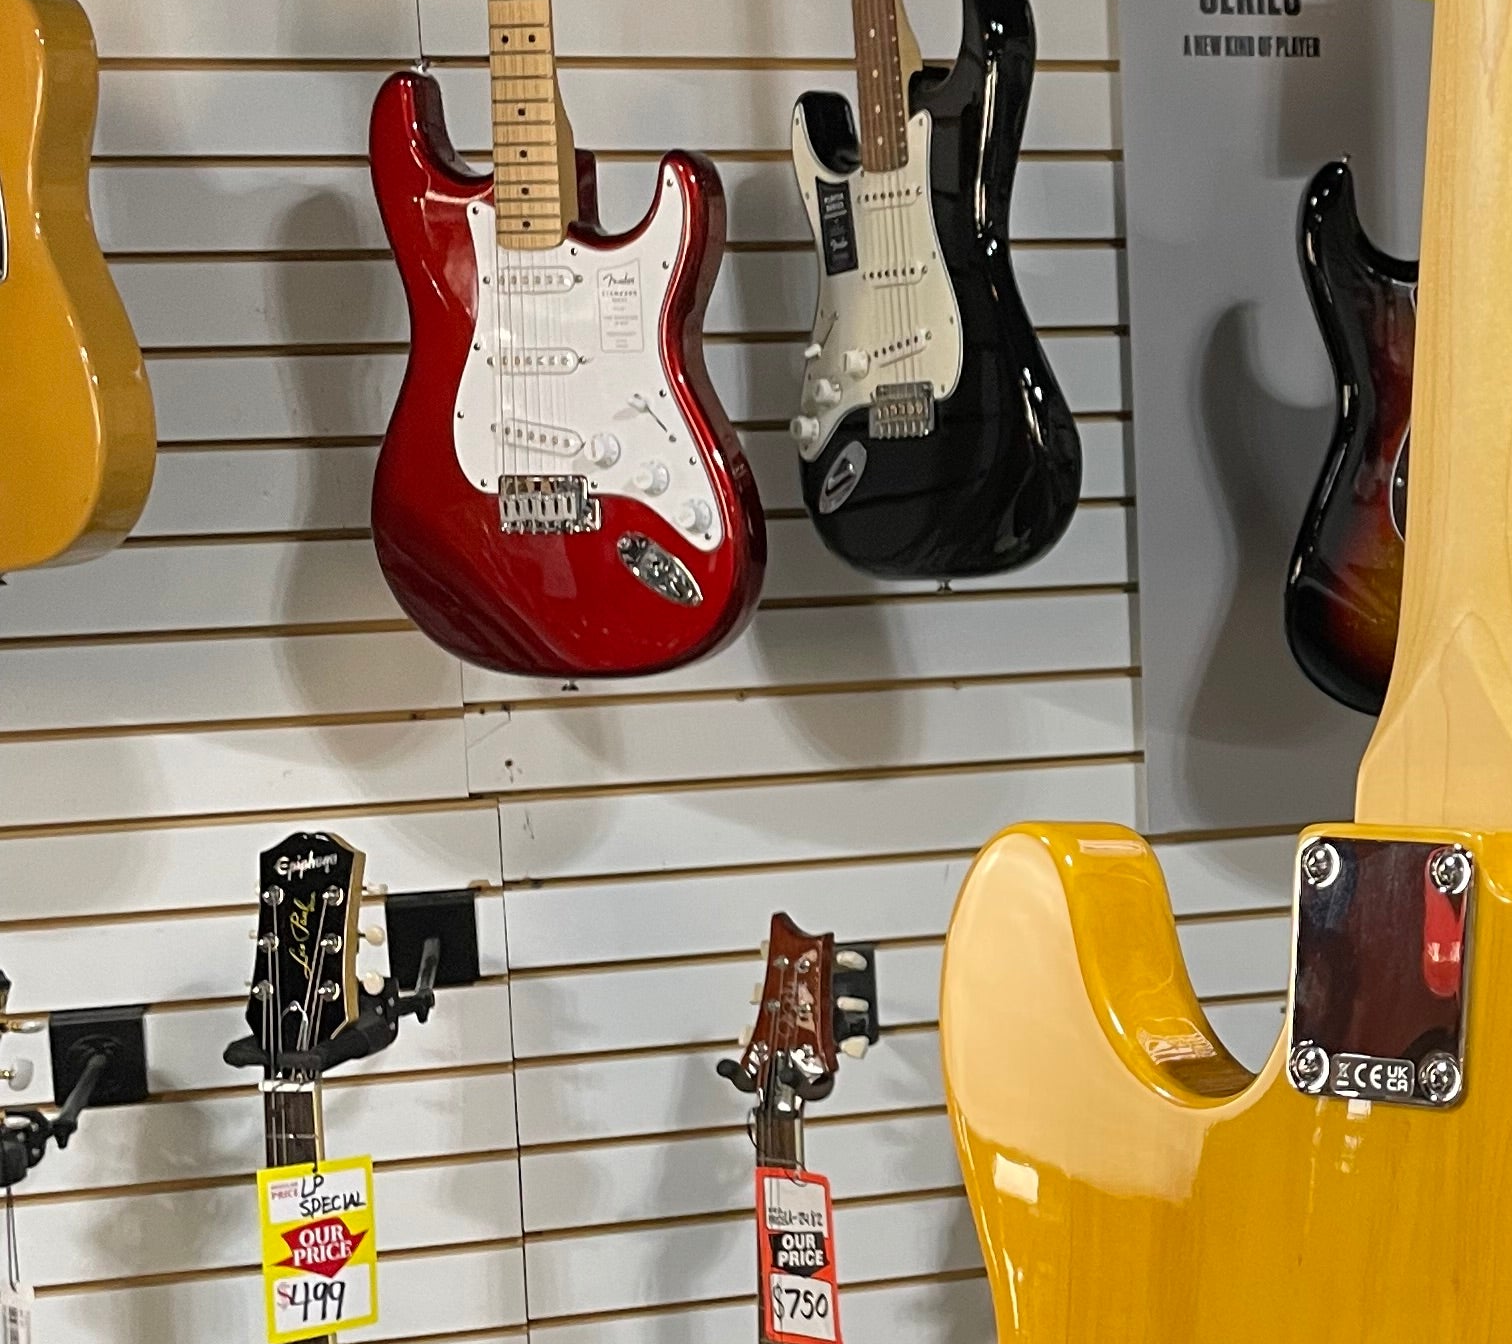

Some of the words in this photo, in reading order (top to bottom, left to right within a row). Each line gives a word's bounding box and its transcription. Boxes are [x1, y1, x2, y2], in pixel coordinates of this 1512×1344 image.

[1184, 34, 1192, 56] A
[1194, 35, 1222, 56] NEW
[1224, 35, 1255, 57] KIND
[1258, 36, 1274, 57] OF
[1276, 36, 1321, 58] PLAYER
[603, 272, 635, 288] Fender
[1386, 1065, 1409, 1079] UK
[1386, 1078, 1409, 1093] CA
[300, 1174, 325, 1198] LP
[299, 1224, 344, 1247] OUR
[781, 1233, 816, 1251] OUR
[293, 1240, 353, 1267] PRICE
[778, 1250, 825, 1268] PRICE
[276, 1280, 346, 1322] $499
[772, 1283, 829, 1323] $750
